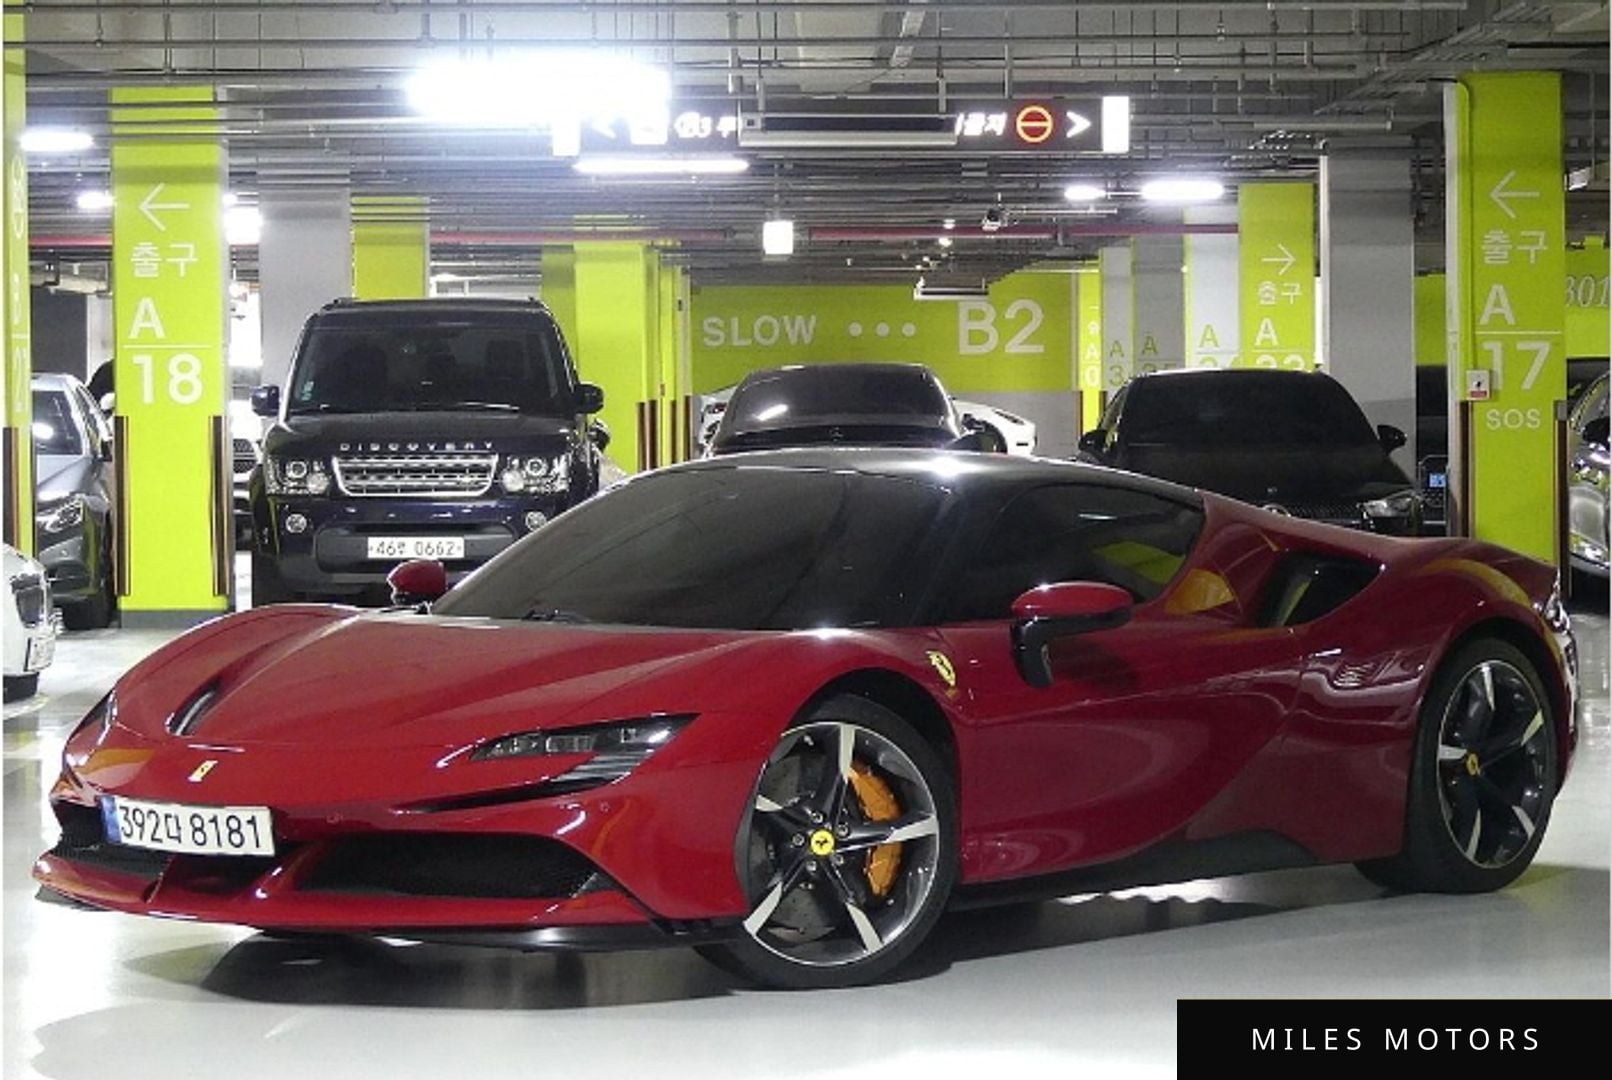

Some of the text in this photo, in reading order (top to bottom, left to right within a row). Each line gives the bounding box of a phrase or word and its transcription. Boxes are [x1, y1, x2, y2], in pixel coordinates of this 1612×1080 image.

[130, 242, 198, 278] 출구
[1482, 229, 1548, 264] 출구
[128, 297, 165, 339] A
[1479, 283, 1516, 325] A
[702, 299, 1045, 355] SLOW B2
[1199, 323, 1219, 348] A
[1254, 317, 1279, 347] A
[1108, 340, 1125, 357] A
[1142, 335, 1158, 355] A
[132, 353, 204, 405] 18
[1482, 341, 1551, 391] 17
[1486, 408, 1541, 429] SOS
[340, 442, 493, 451] DISCOVERY
[118, 805, 261, 849] 392다 8181
